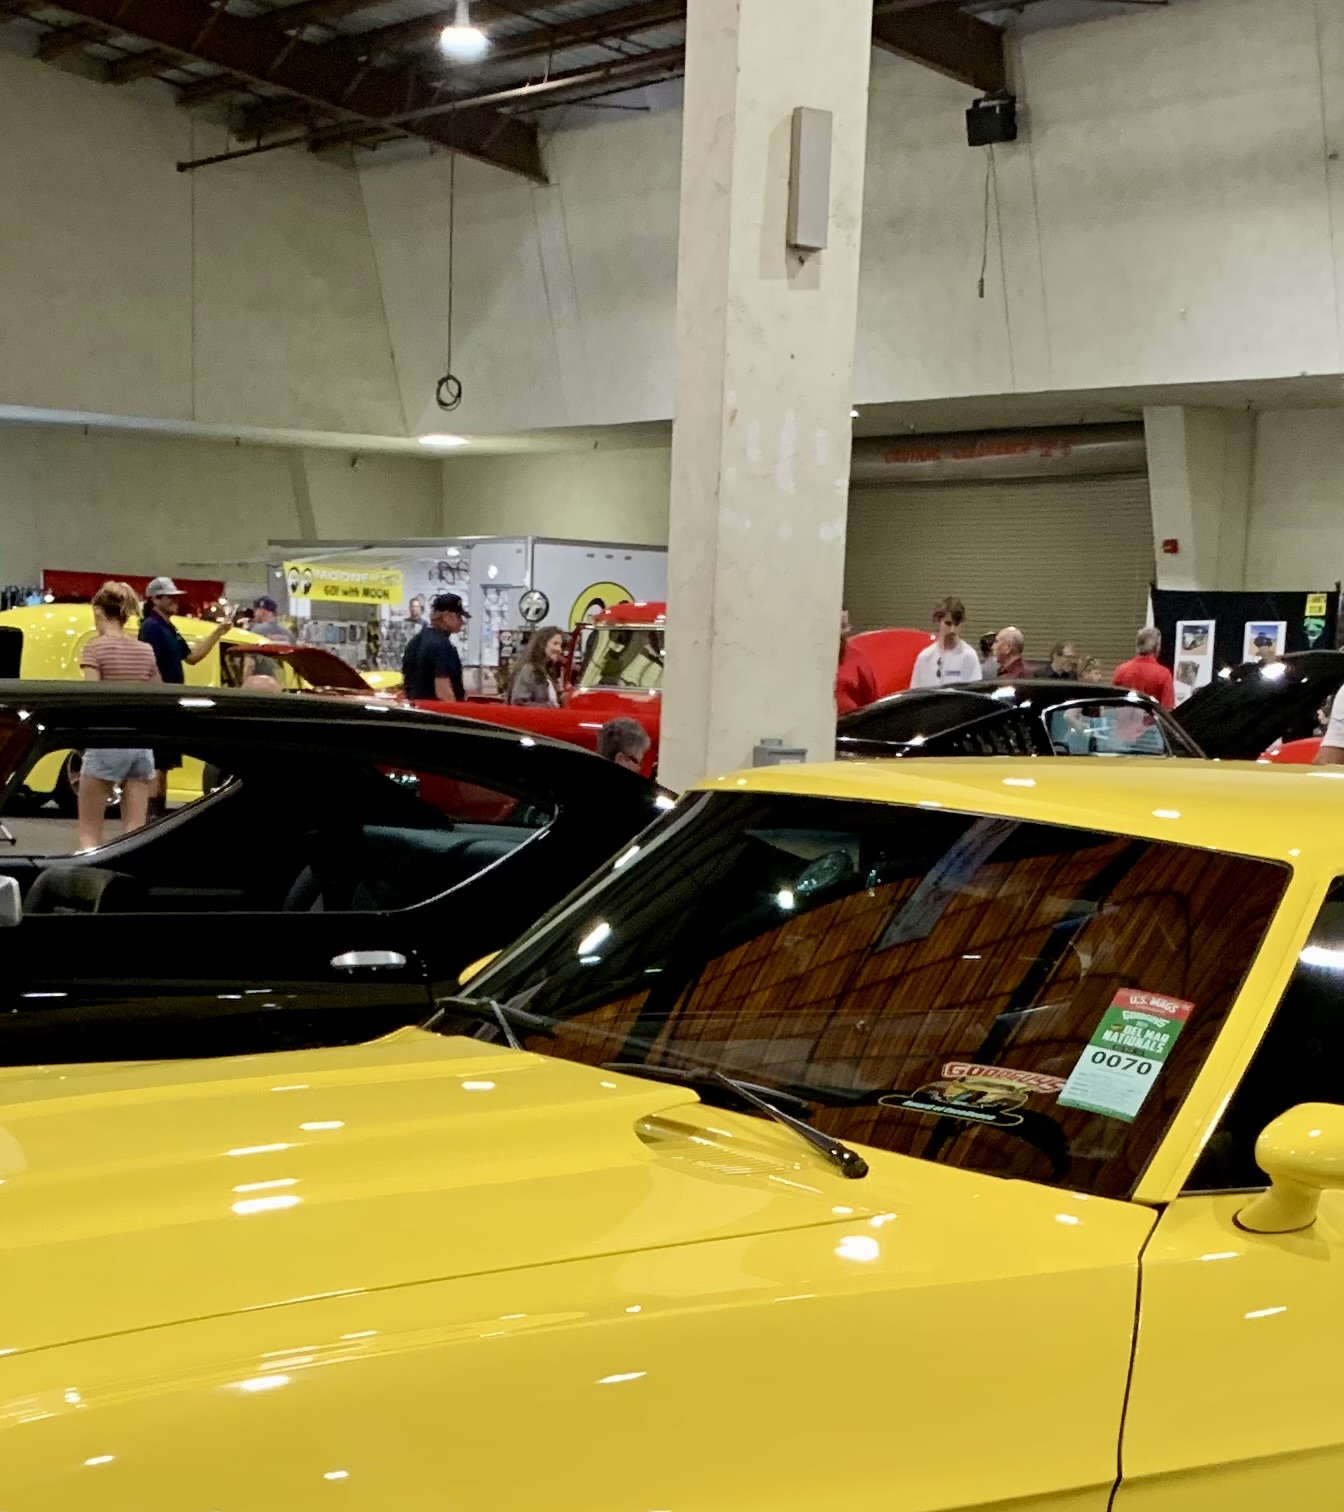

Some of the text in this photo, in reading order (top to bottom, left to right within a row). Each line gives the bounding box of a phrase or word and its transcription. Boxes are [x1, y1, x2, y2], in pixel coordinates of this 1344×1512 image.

[361, 586, 391, 600] MOON
[1102, 1029, 1166, 1053] NATIONALS
[1123, 1025, 1170, 1043] DEL MAR
[1091, 1051, 1152, 1075] 0070
